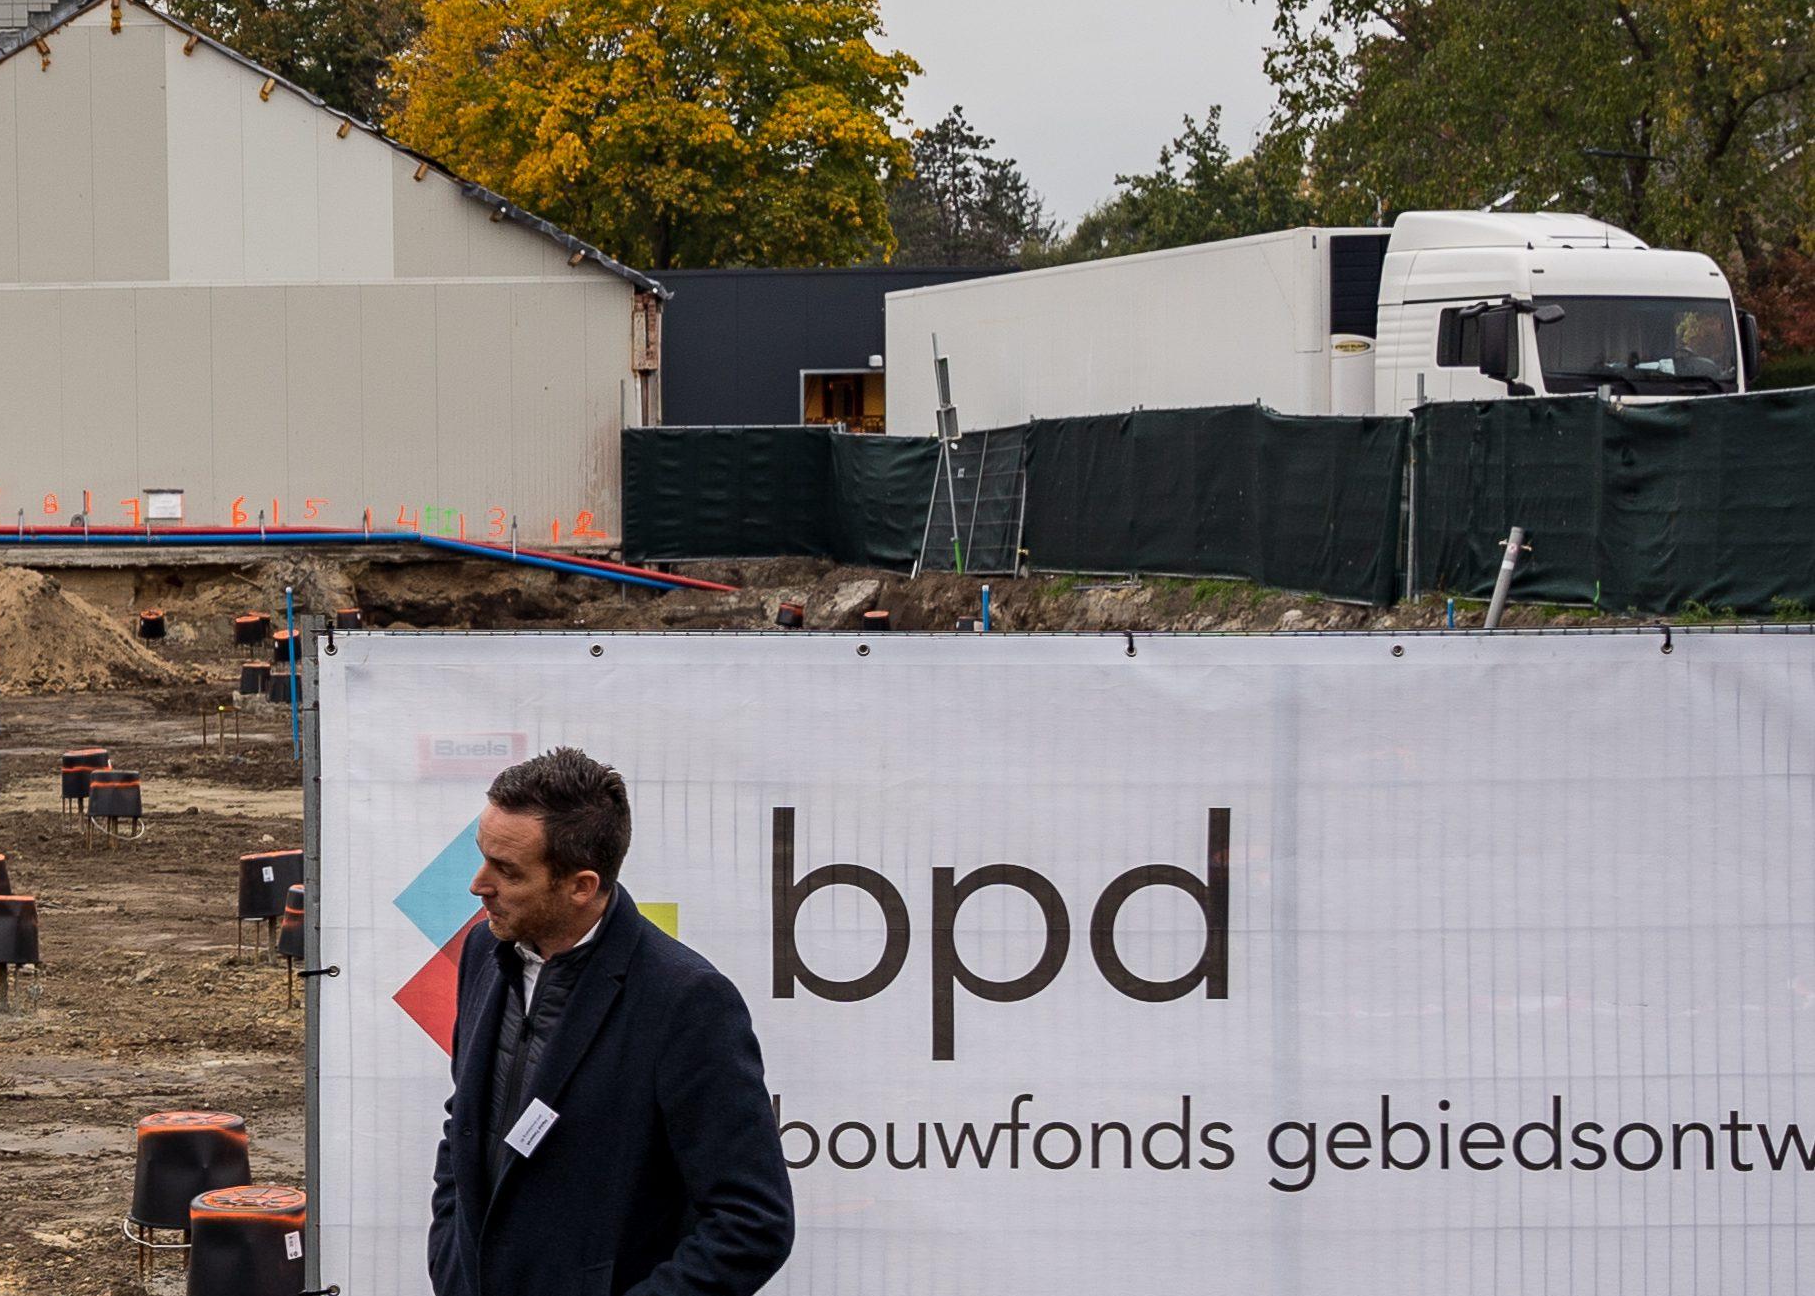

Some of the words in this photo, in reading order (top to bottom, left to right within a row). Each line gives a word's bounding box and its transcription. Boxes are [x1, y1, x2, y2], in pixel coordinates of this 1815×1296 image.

[434, 739, 508, 757] Boels
[772, 806, 1231, 1061] bpd
[772, 1094, 1235, 1171] bouwfonds
[1267, 1094, 1815, 1193] gebiedsontw
